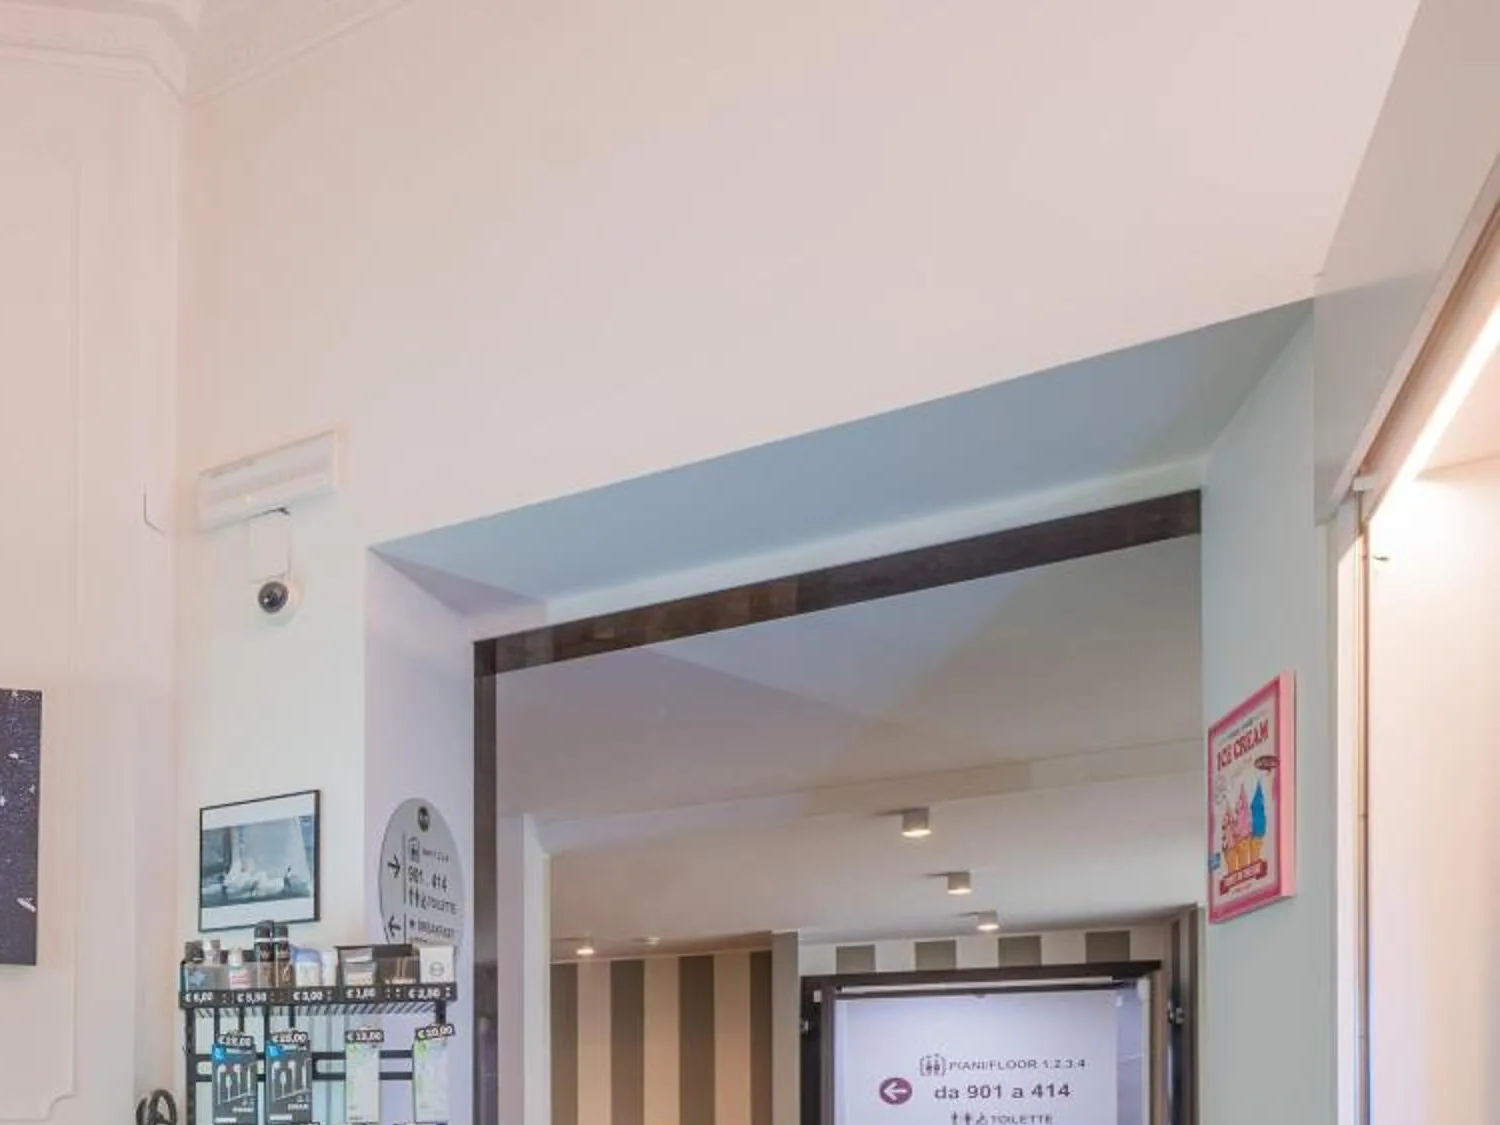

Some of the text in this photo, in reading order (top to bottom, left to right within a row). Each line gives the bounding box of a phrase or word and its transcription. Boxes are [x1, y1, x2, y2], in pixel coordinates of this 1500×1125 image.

[1217, 746, 1232, 772] ICE
[1233, 719, 1269, 760] CREAM
[934, 1083, 1071, 1100] da 901 a 414
[991, 1114, 1053, 1125] TOILETTE
